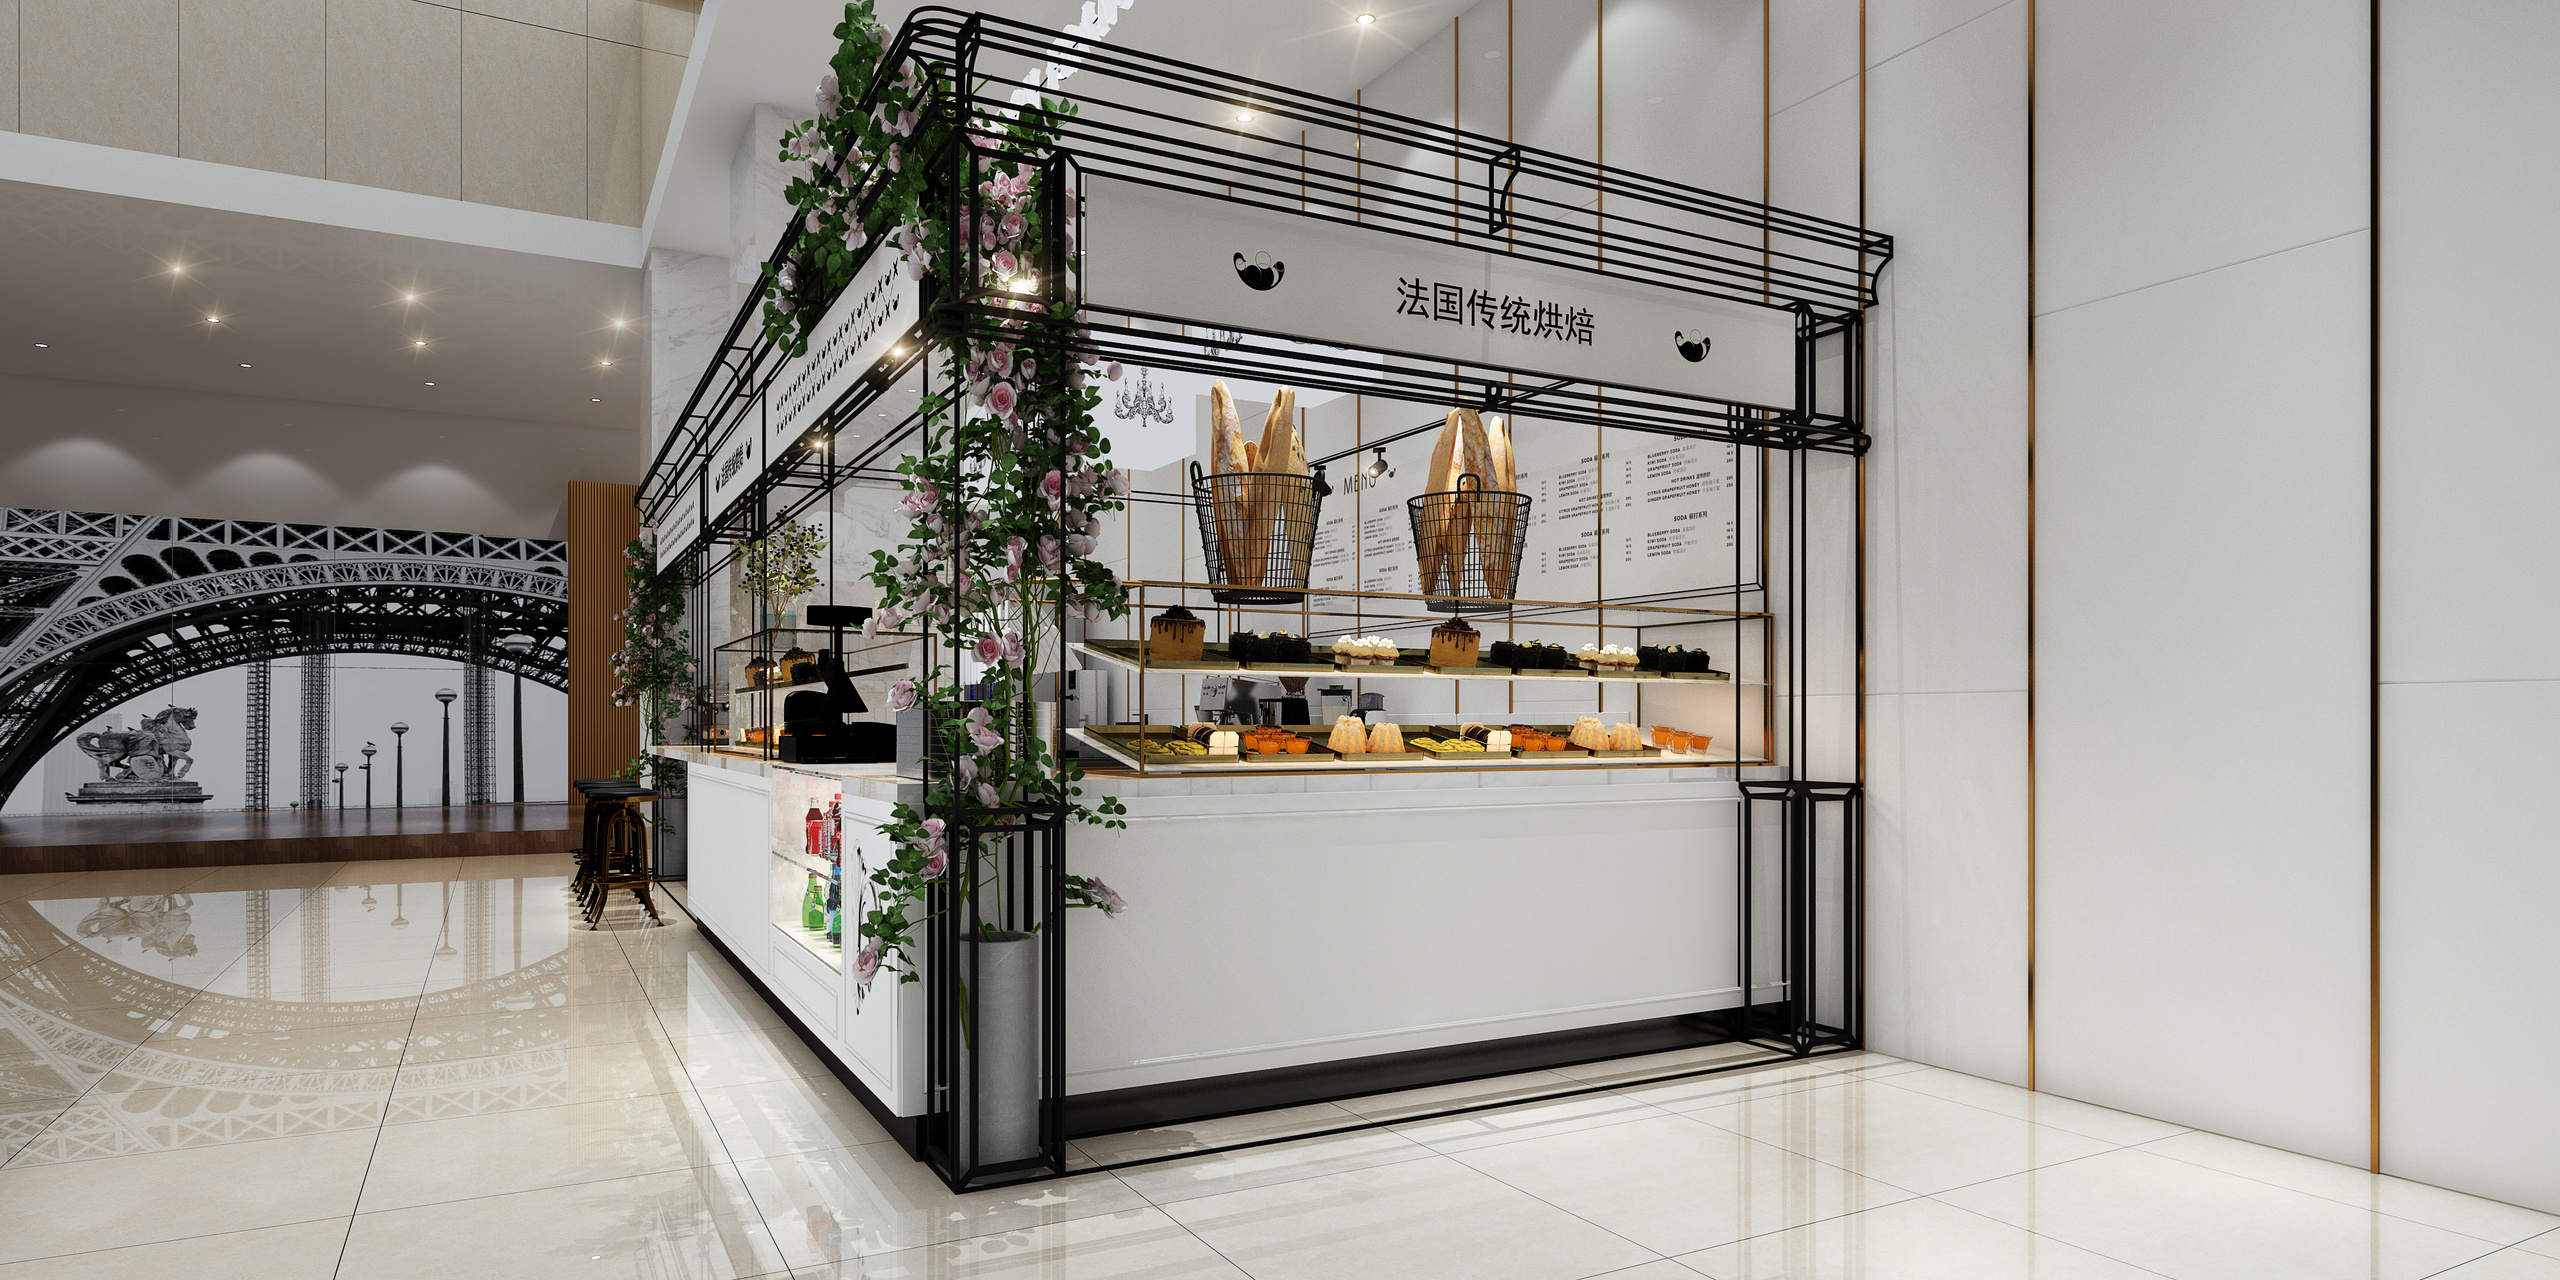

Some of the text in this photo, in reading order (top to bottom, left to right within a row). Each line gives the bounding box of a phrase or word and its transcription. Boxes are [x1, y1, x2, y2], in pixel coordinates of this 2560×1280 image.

[1397, 277, 1595, 346] 法国传统烘焙
[1647, 450, 1669, 459] BLUEBERRY
[1647, 464, 1670, 472] GRAPEFRUIT
[1662, 485, 1686, 493] GRAPEFRUIT
[1662, 492, 1686, 500] GRAPEFRUIT
[1647, 529, 1669, 537] BLUEBERRY
